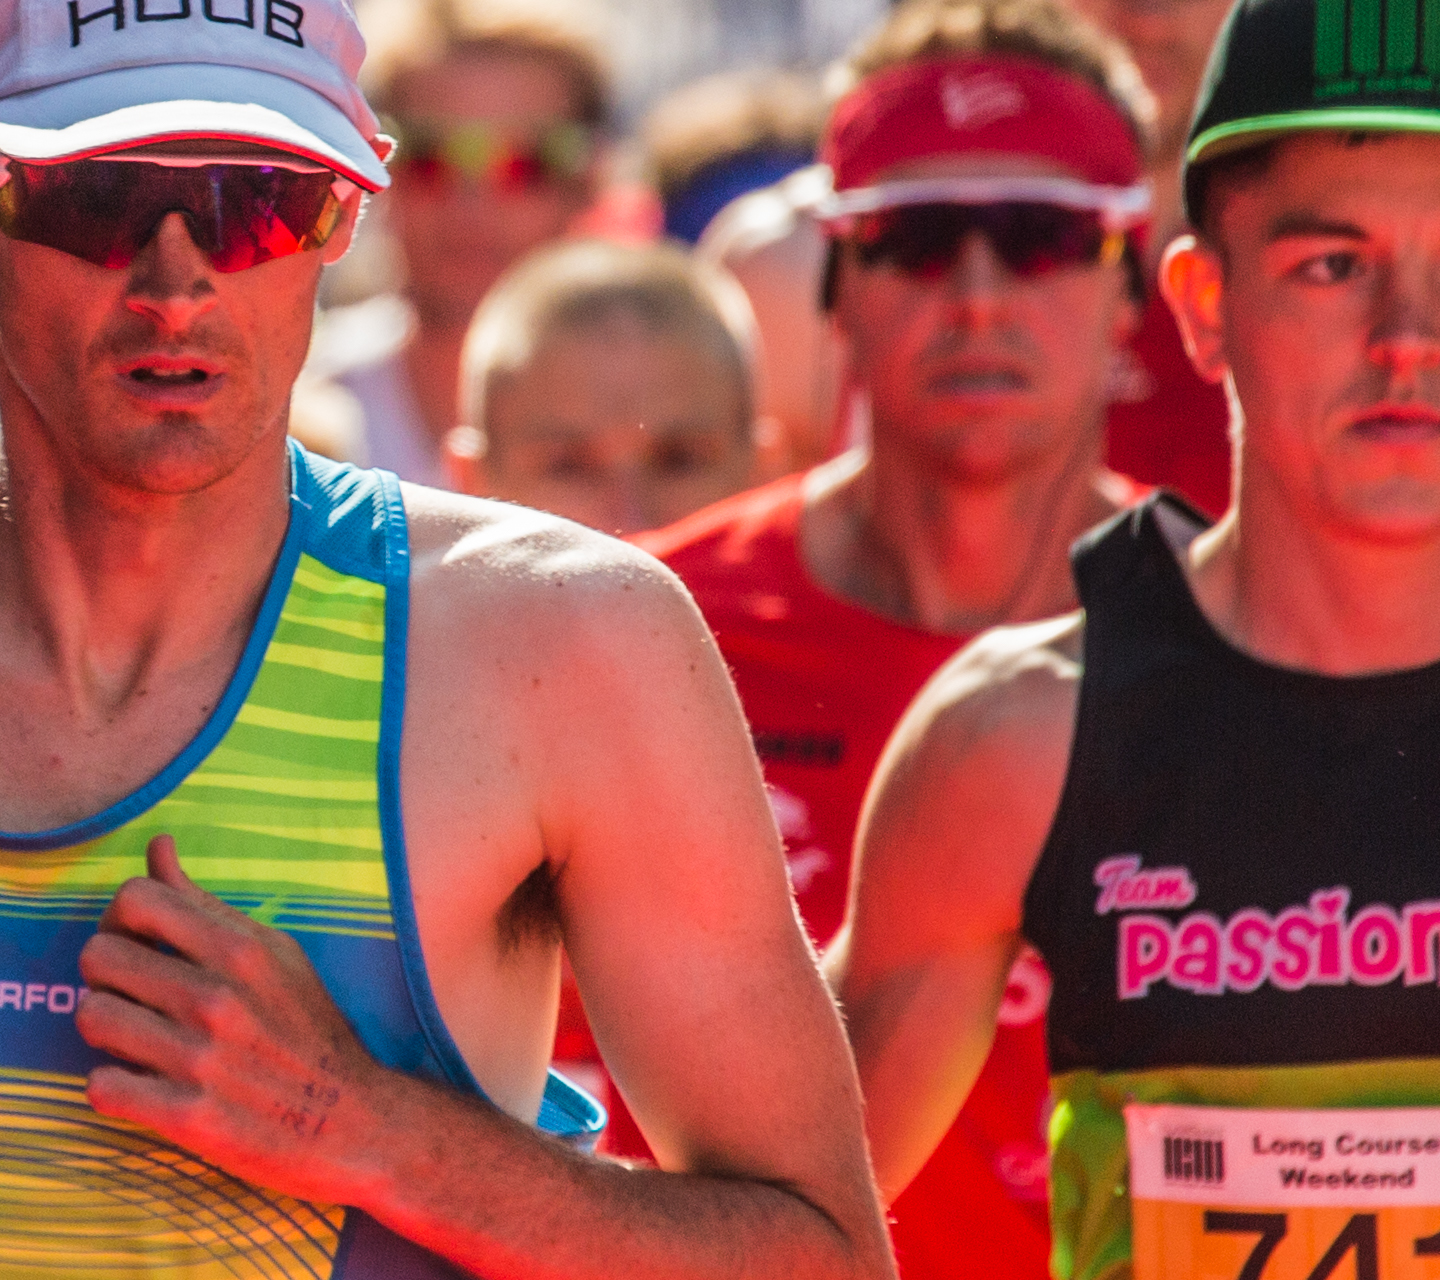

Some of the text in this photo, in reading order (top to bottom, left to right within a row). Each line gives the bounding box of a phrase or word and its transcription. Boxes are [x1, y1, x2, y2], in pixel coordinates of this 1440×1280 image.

[1094, 854, 1198, 916] Team
[1252, 1133, 1324, 1160] Long
[1279, 1167, 1416, 1190] Weekend
